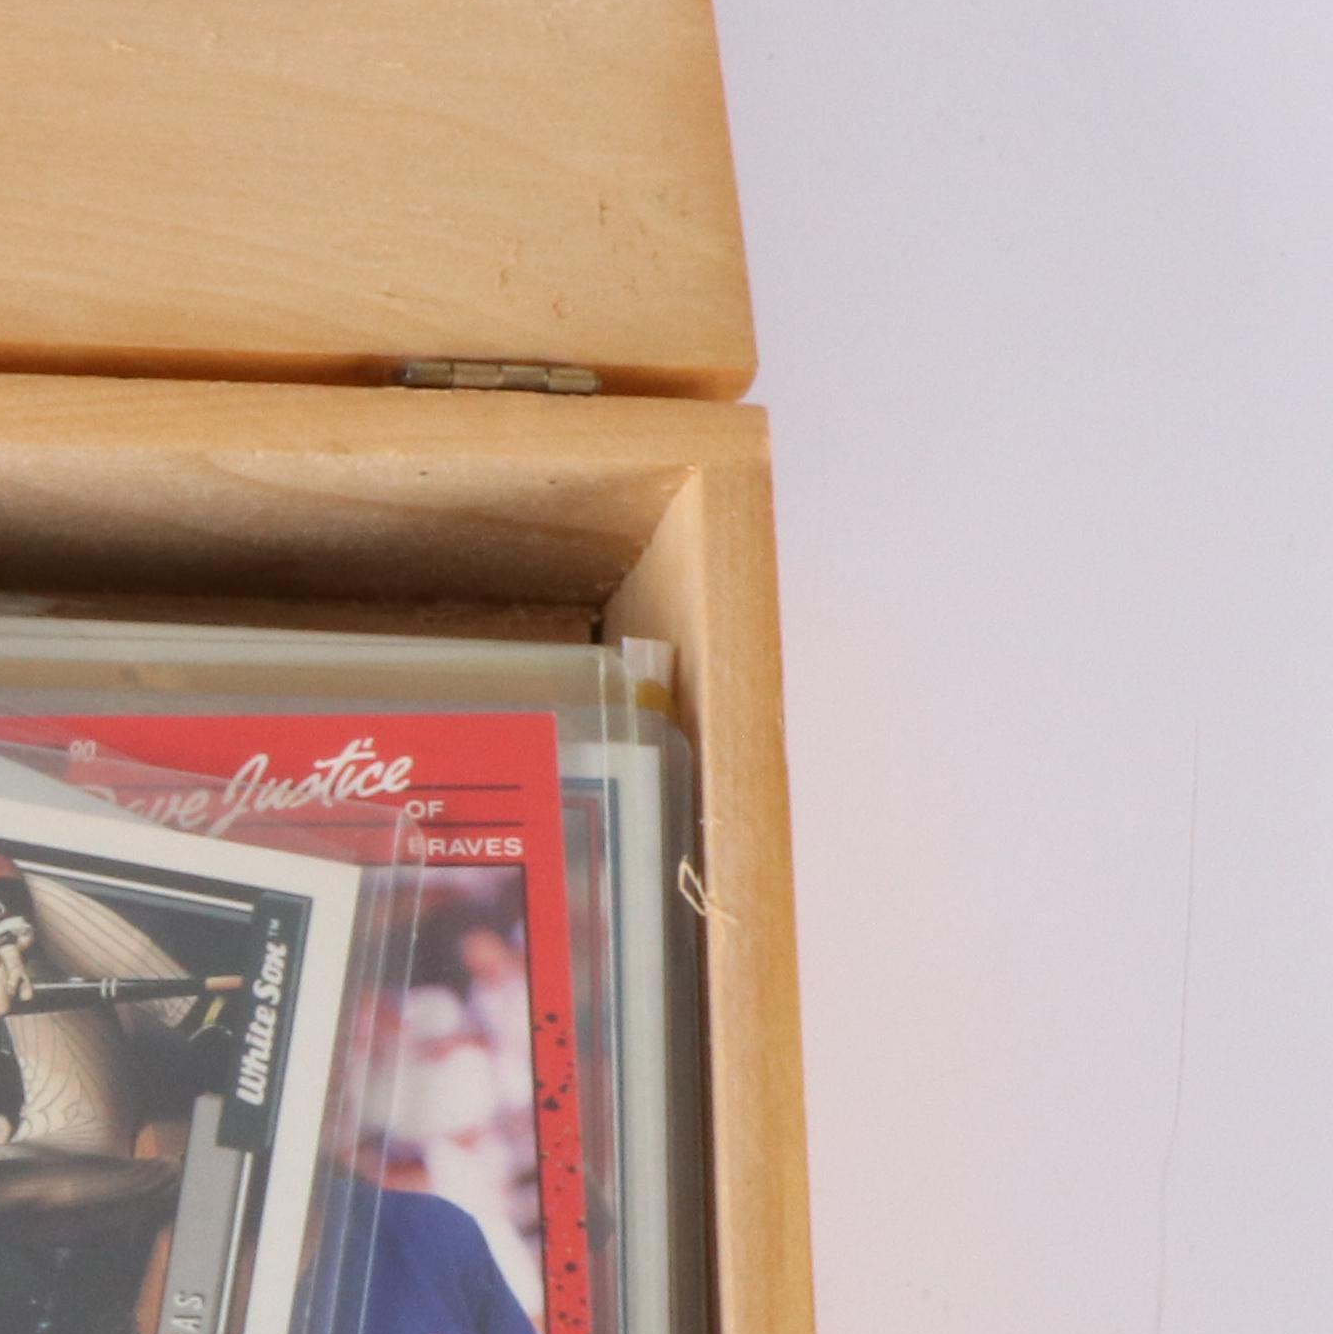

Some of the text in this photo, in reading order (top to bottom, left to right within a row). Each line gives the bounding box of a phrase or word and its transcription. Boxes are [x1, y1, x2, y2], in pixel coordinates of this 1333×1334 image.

[205, 736, 414, 839] Justice
[404, 799, 445, 820] OF
[408, 836, 525, 858] BRAVES
[235, 1003, 276, 1106] White
